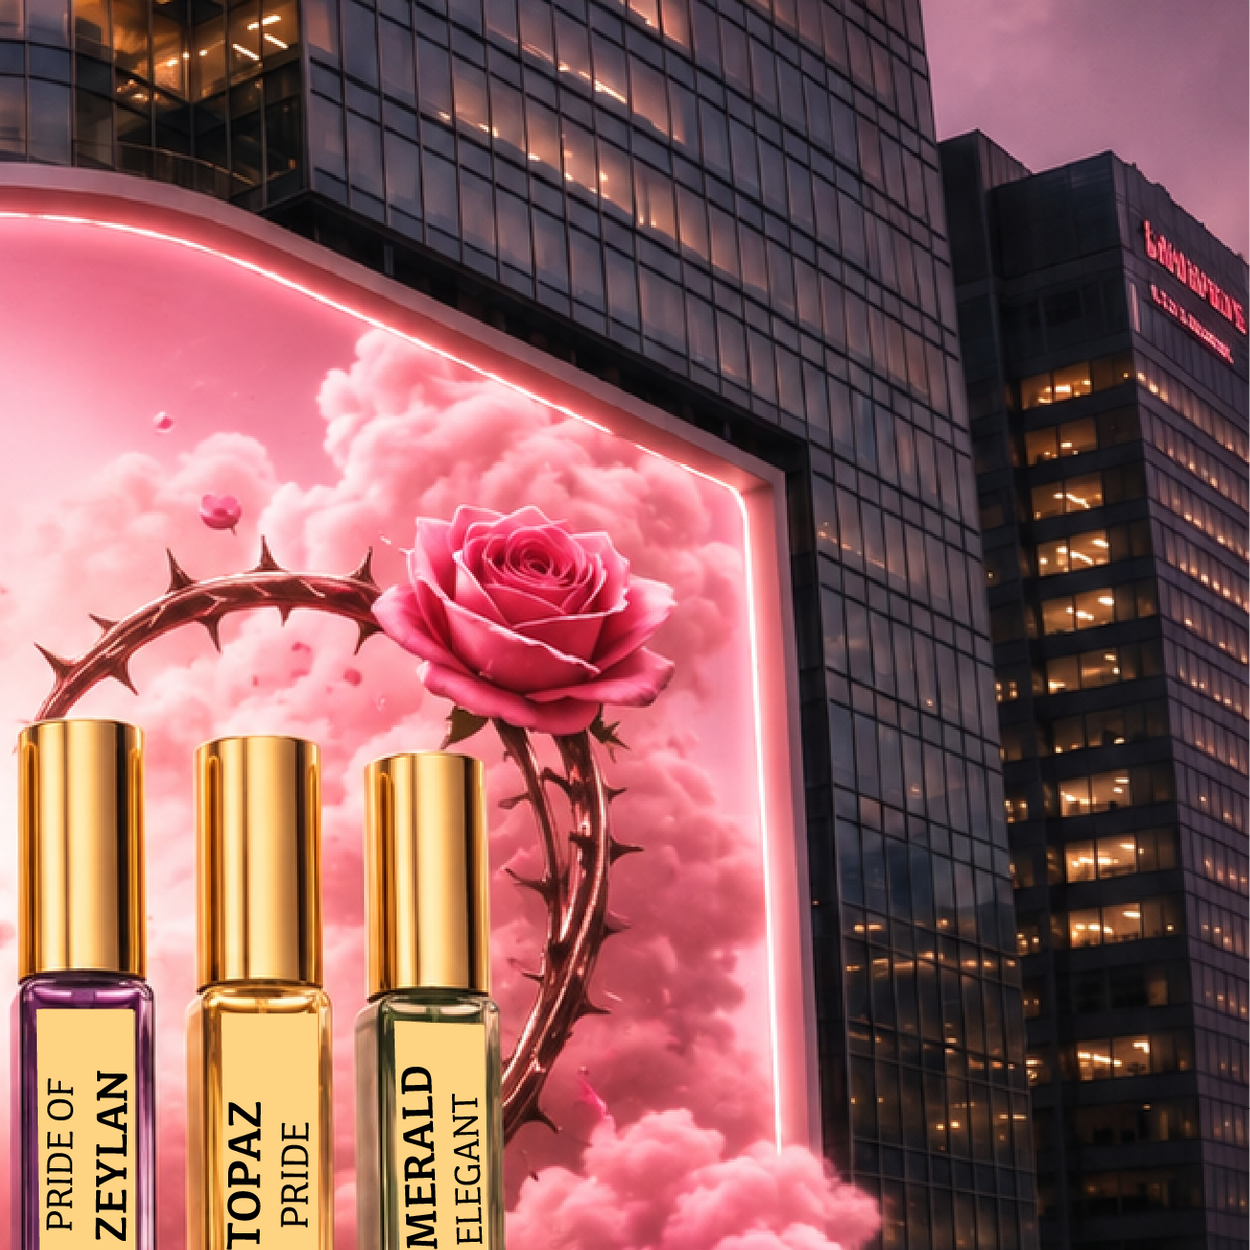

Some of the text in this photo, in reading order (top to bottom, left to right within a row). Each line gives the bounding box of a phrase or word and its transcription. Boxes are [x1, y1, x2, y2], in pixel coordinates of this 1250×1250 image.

[45, 1077, 74, 1231] PRIDE OF
[95, 1070, 128, 1242] ZEYLAN
[226, 1101, 262, 1250] TOPAZ
[280, 1122, 310, 1228] PRIDE
[451, 1093, 483, 1246] ELEGANT
